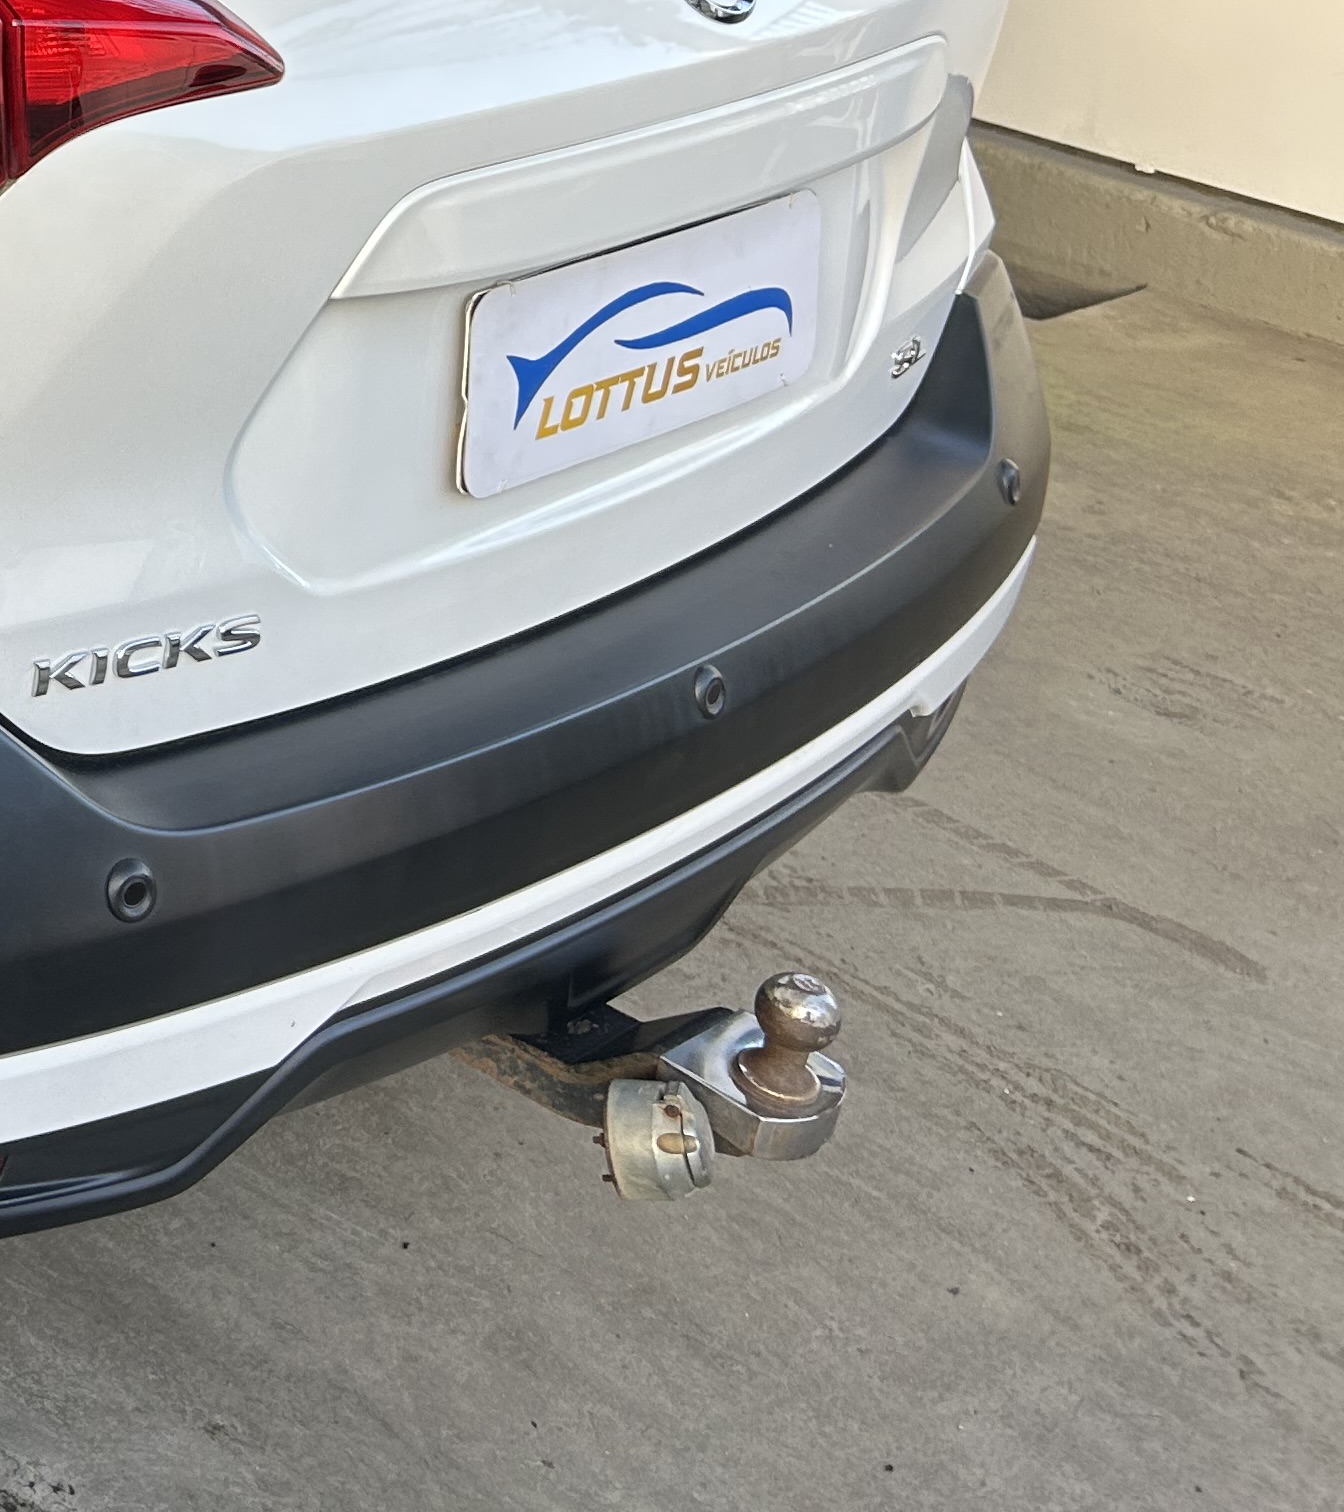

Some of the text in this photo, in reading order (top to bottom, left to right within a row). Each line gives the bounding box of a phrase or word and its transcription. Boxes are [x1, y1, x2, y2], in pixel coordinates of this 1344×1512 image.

[534, 336, 782, 441] LOTTUS VEÍCULOS
[30, 613, 262, 698] KICKS
